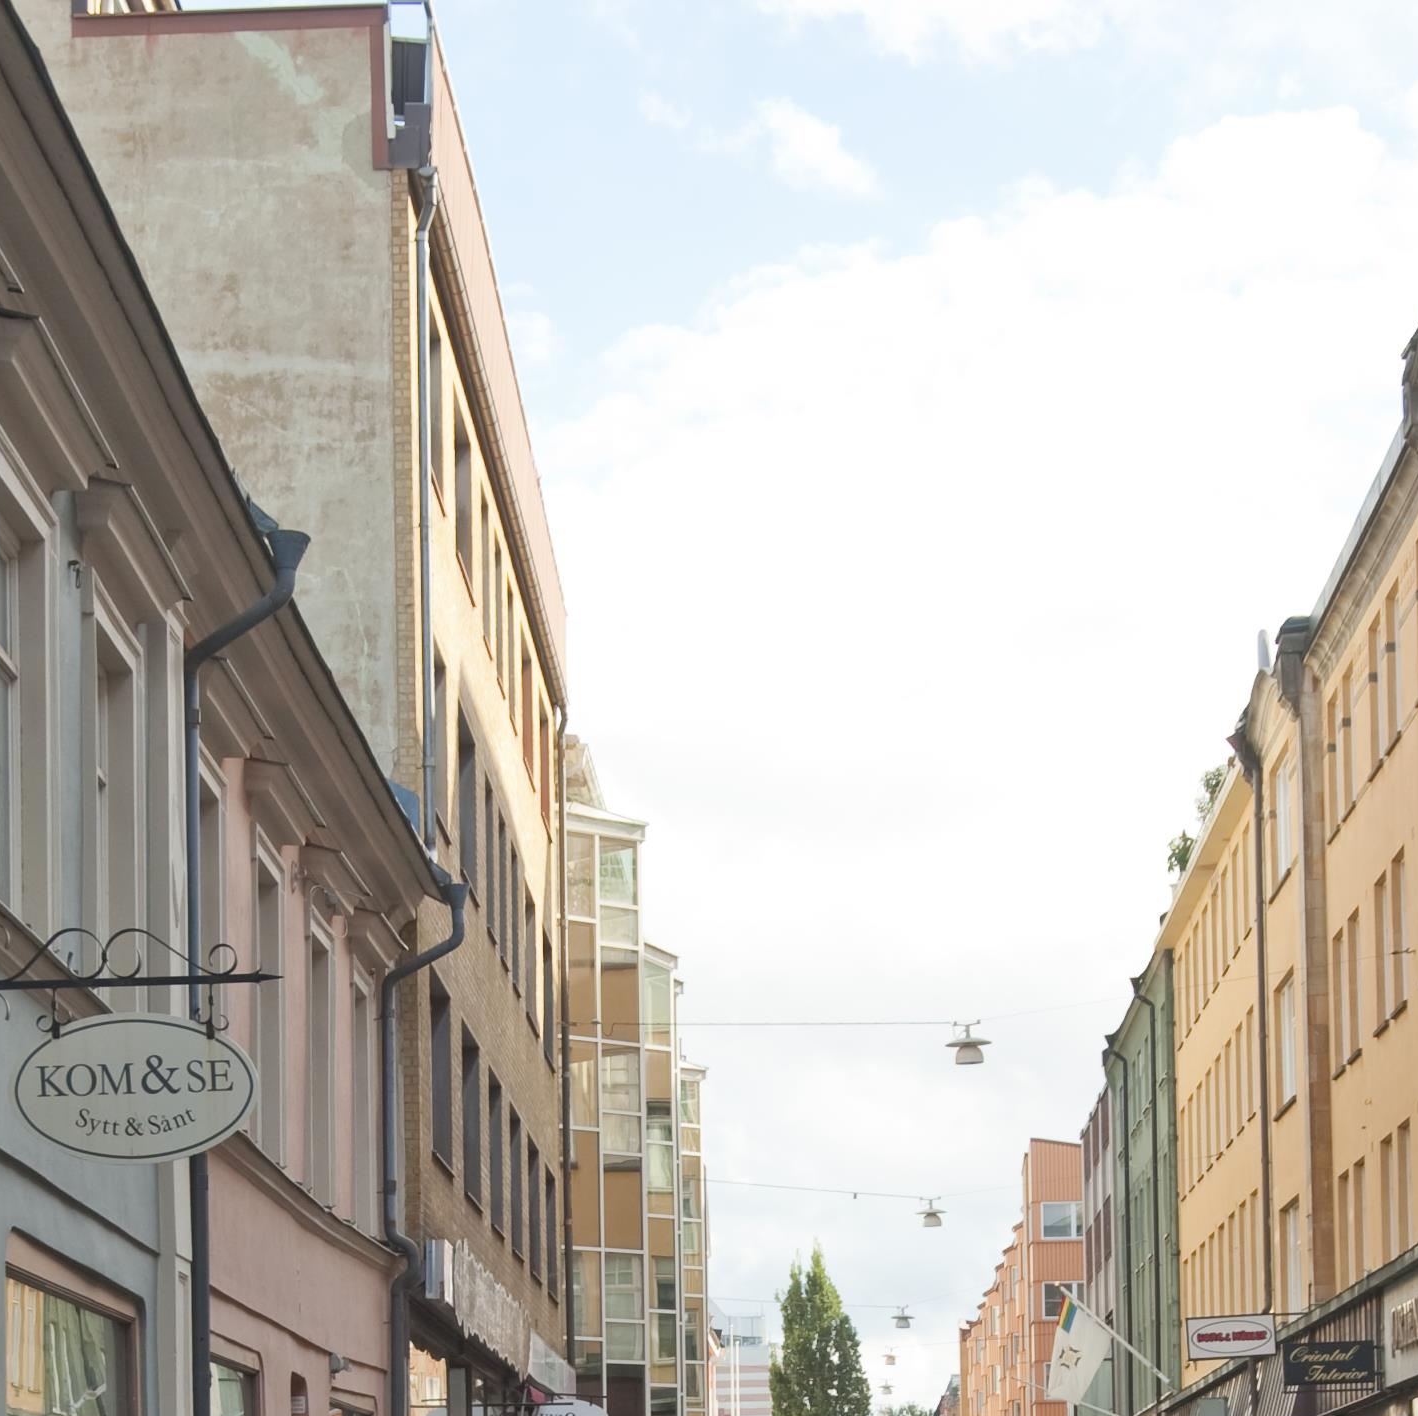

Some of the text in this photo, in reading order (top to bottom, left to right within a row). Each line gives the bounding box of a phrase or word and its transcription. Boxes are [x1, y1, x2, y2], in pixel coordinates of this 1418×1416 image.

[75, 1108, 196, 1136] Sytt & Sånt
[1290, 1345, 1360, 1363] Oriental
[1304, 1365, 1368, 1382] Interior
